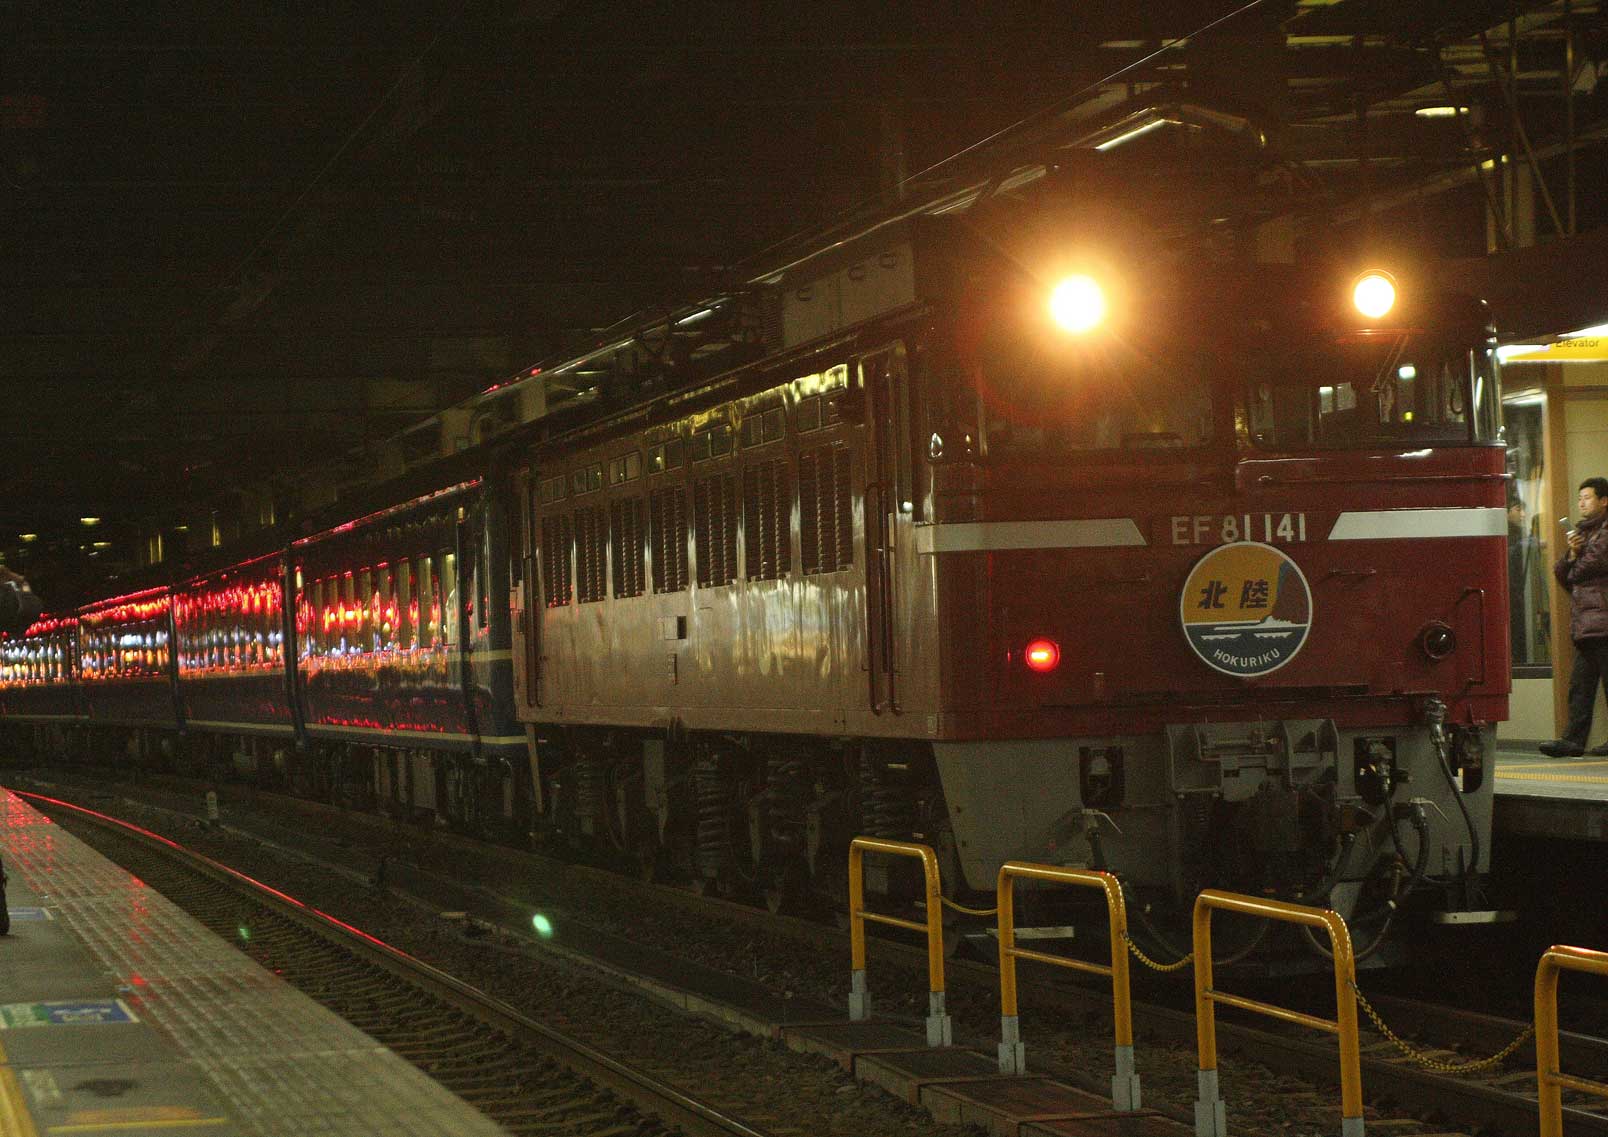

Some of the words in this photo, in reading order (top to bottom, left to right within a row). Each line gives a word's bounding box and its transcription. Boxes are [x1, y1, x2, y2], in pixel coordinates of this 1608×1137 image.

[1171, 516, 1211, 544] EF
[1221, 514, 1251, 542] 81
[1265, 513, 1306, 542] 141
[1198, 579, 1269, 609] 北陸
[1213, 648, 1281, 668] HOKURIKU
